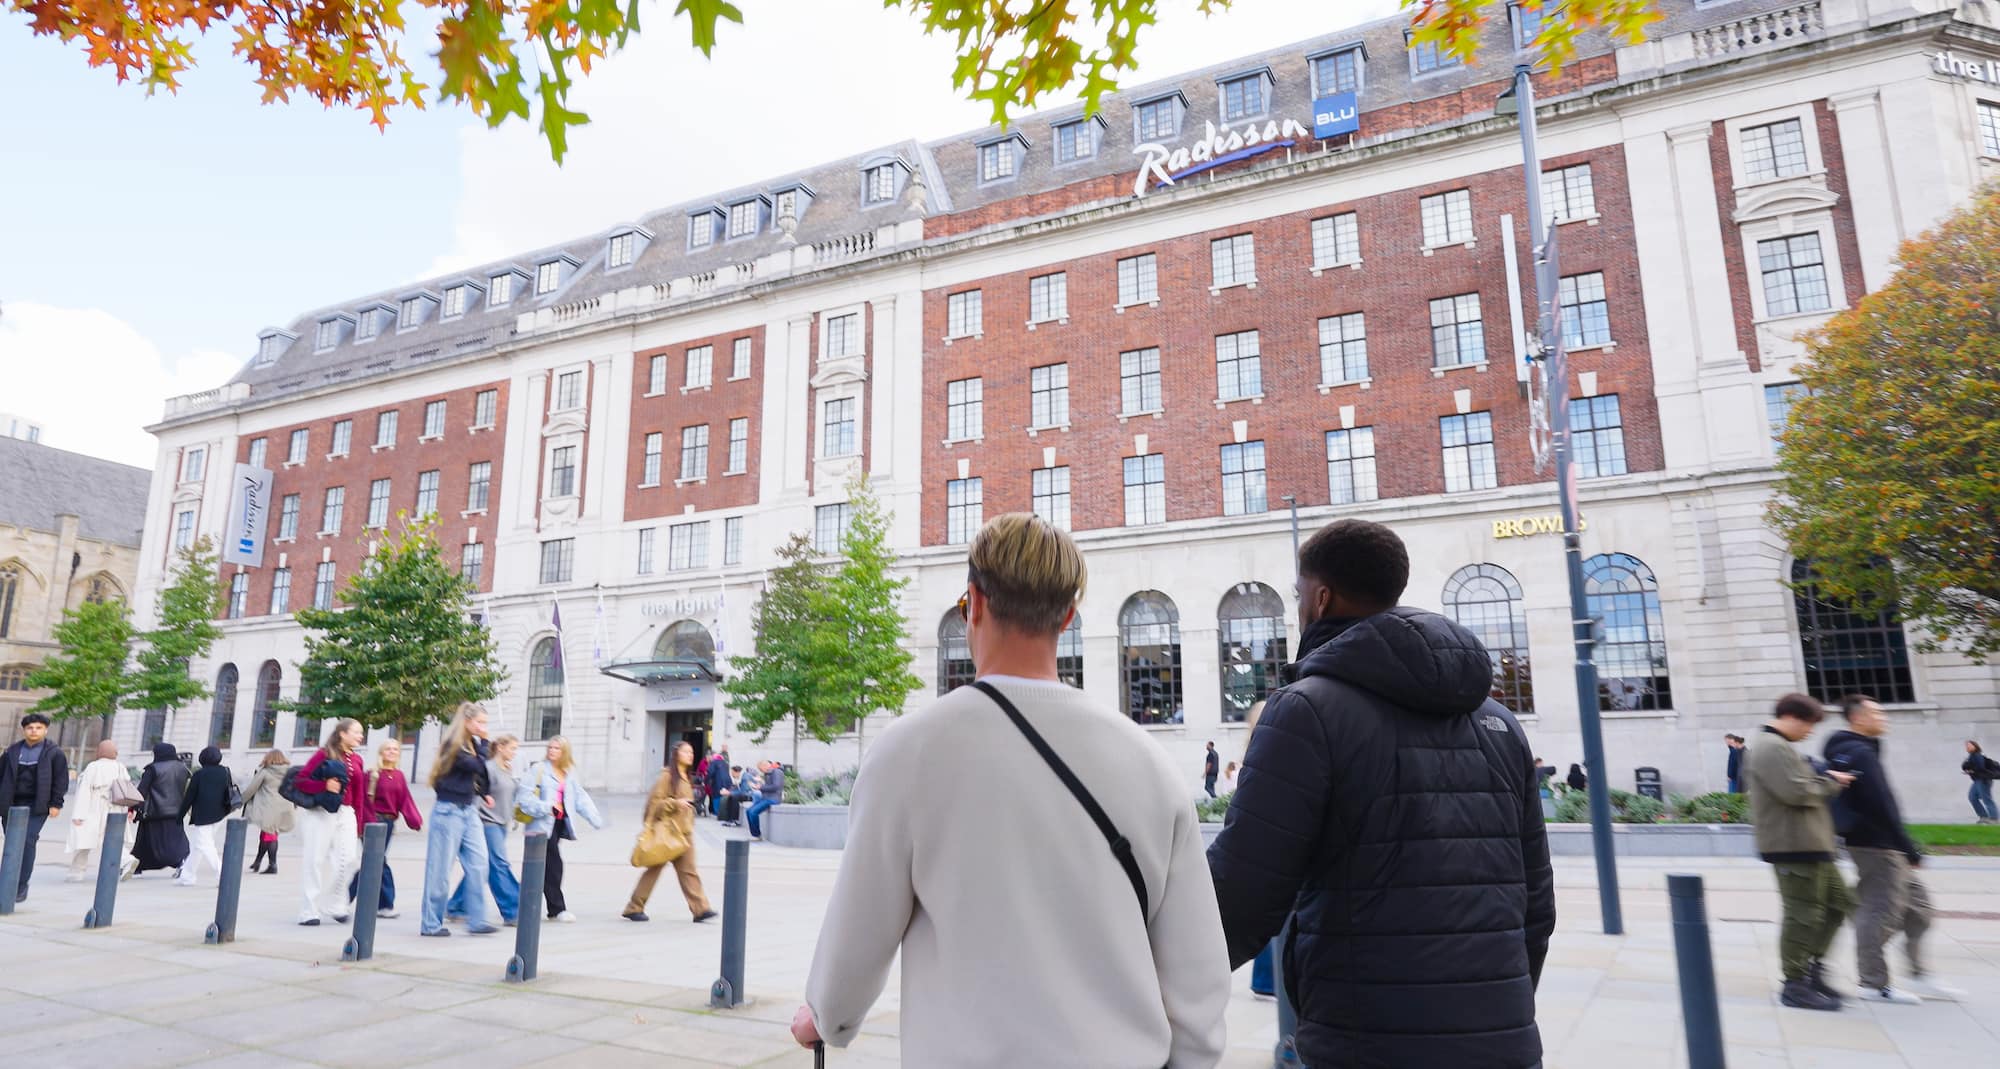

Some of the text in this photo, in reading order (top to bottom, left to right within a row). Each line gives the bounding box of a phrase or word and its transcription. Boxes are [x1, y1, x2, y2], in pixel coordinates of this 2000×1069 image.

[1935, 51, 1982, 79] the
[1316, 106, 1355, 126] BLU
[1132, 118, 1308, 197] Radisson
